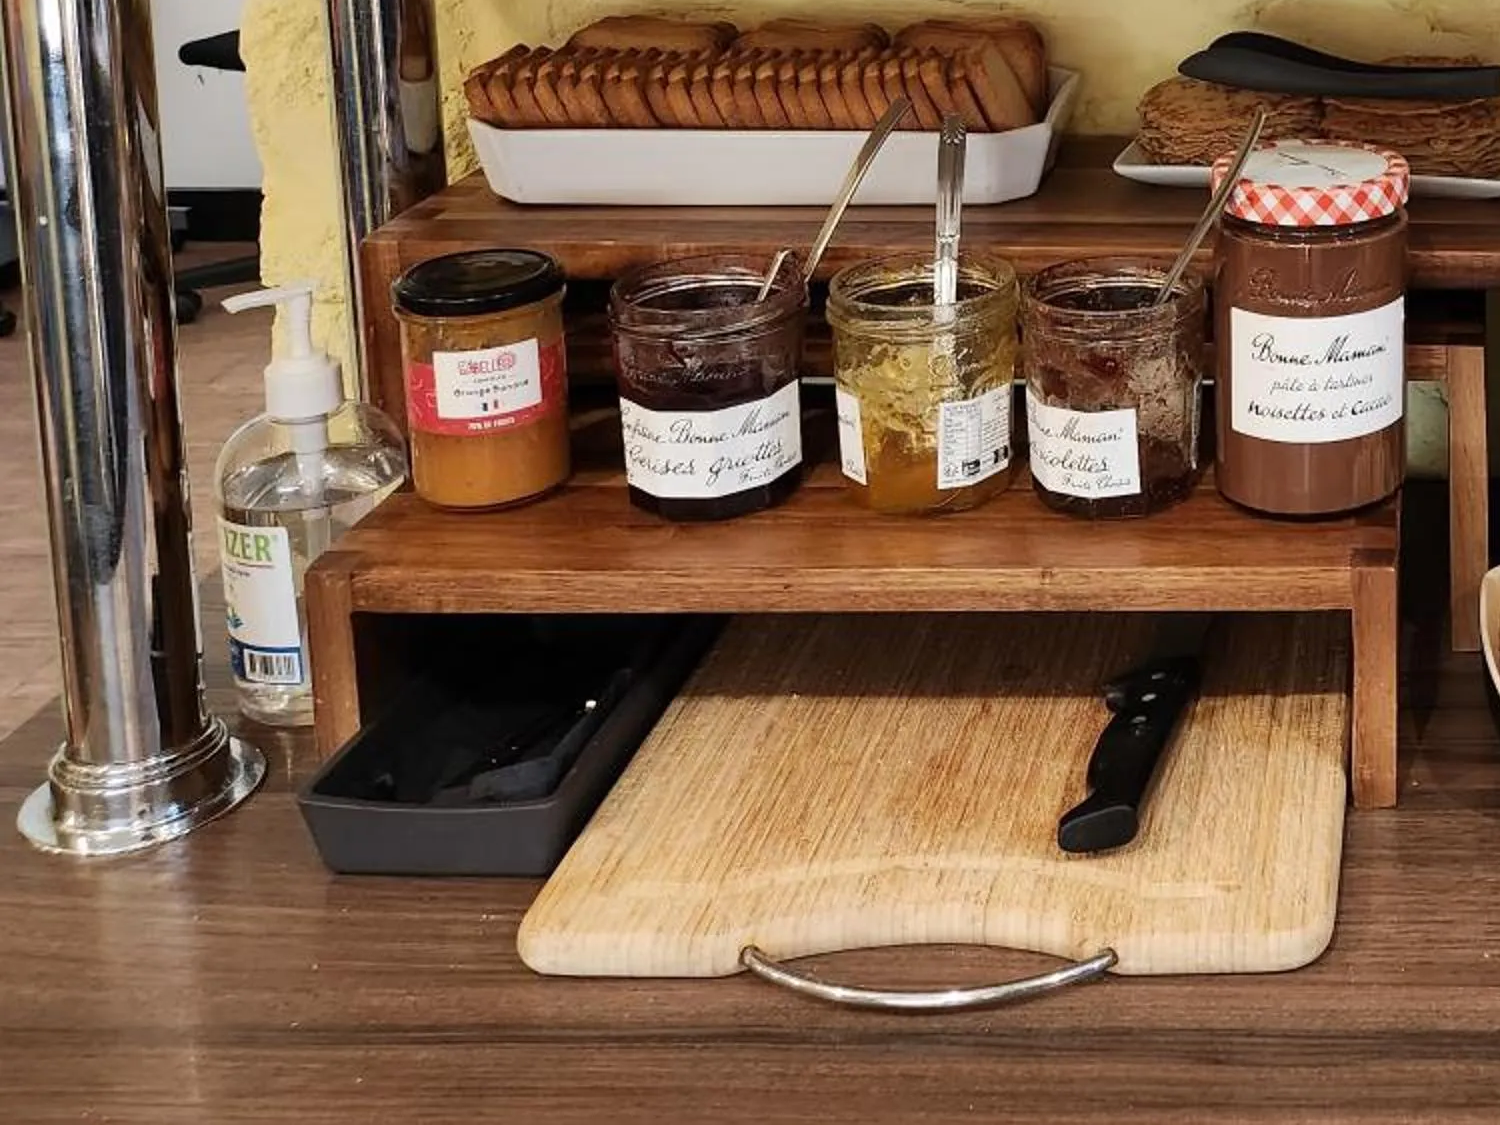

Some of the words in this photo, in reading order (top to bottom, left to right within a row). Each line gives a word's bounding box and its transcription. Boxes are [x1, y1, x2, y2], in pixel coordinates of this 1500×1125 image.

[1251, 332, 1312, 366] Bonne
[668, 418, 729, 445] Bonne
[628, 445, 697, 476] Cerises
